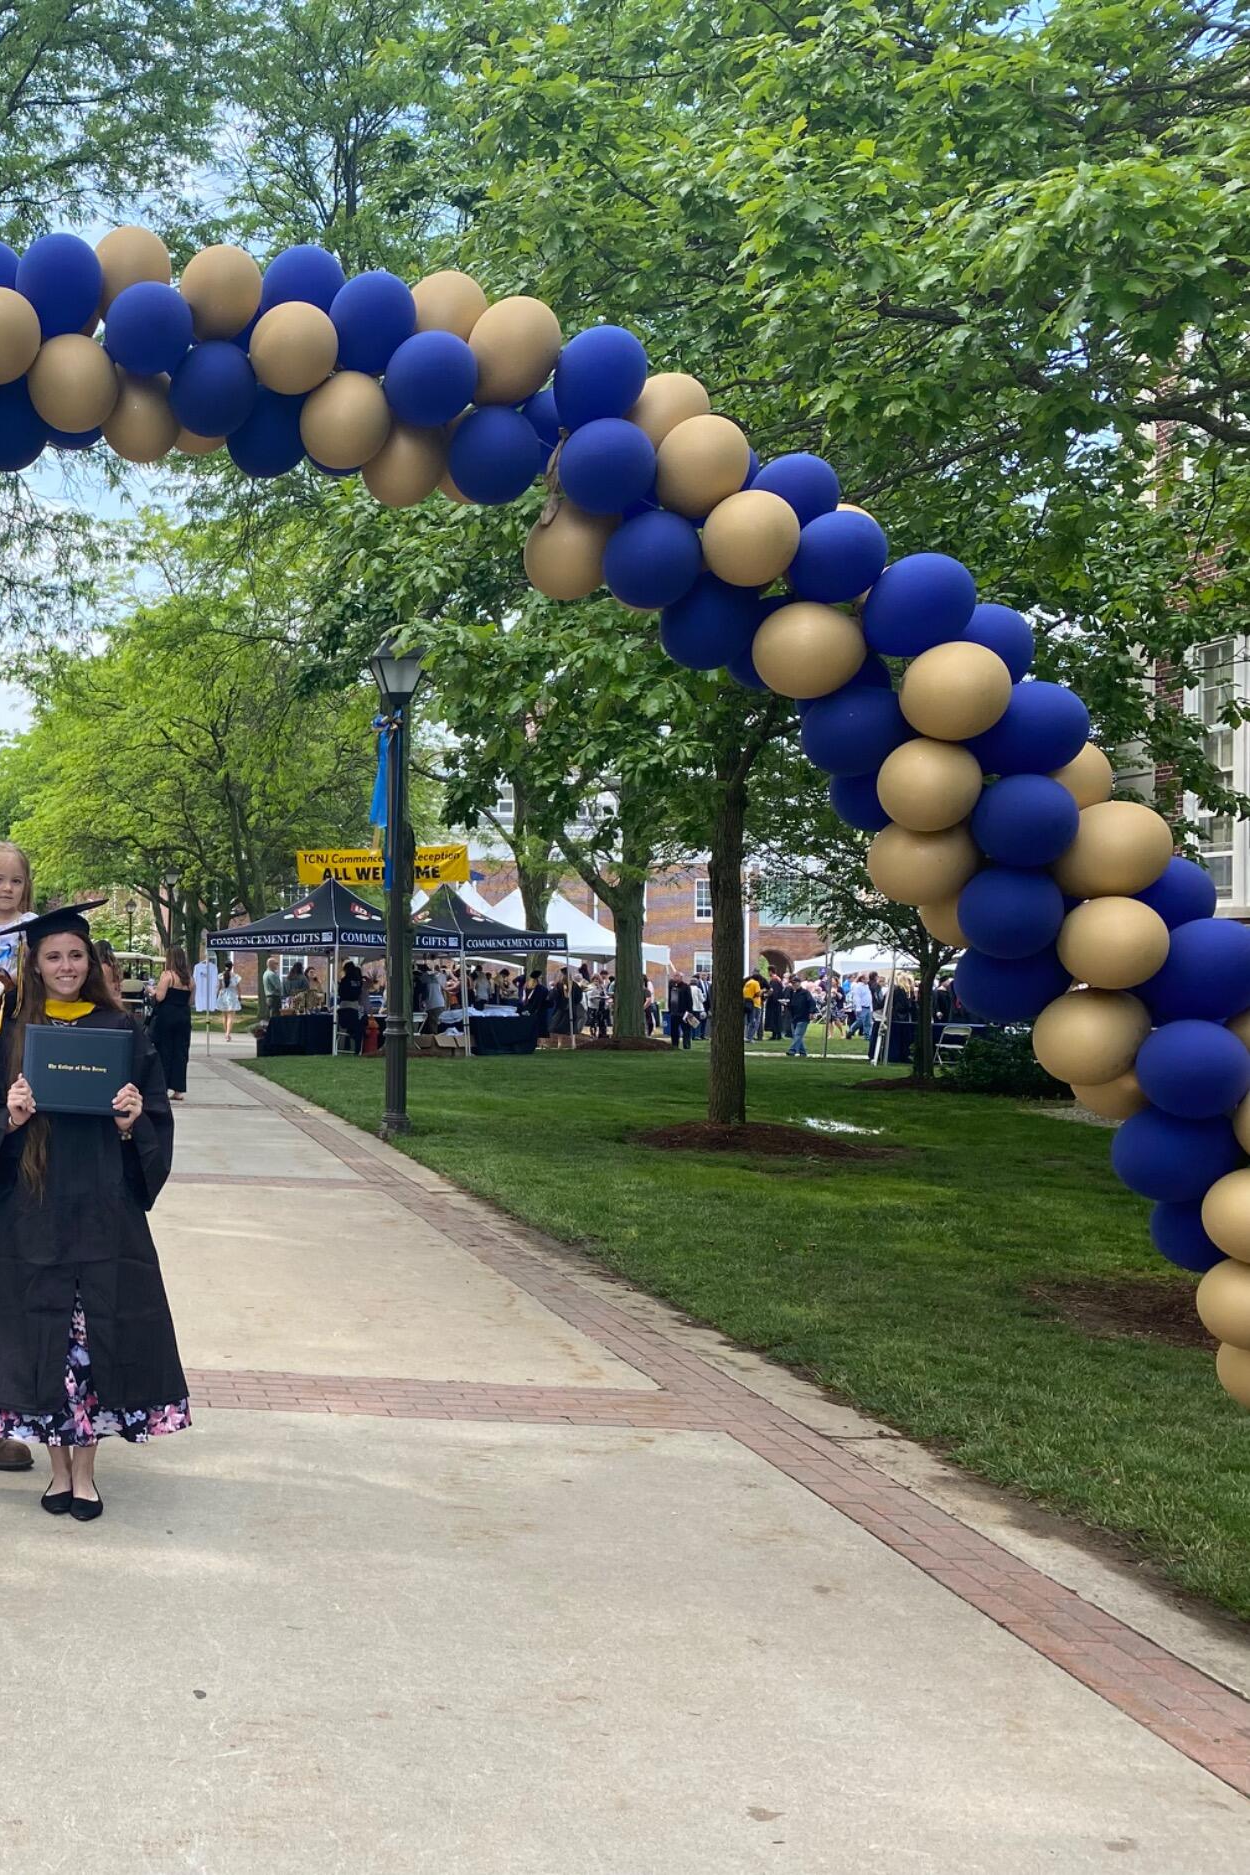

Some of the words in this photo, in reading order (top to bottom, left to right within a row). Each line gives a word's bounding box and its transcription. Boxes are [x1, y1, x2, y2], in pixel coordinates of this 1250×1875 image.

[304, 854, 329, 864] TCNJ
[332, 853, 384, 864] Commence
[322, 867, 351, 881] ALL
[210, 934, 290, 946] COMMENCEMENT
[291, 932, 320, 944] GIFTS
[422, 935, 448, 947] GIFTS
[466, 938, 533, 948] COMMENCEMENT
[533, 938, 555, 948] GIFTS
